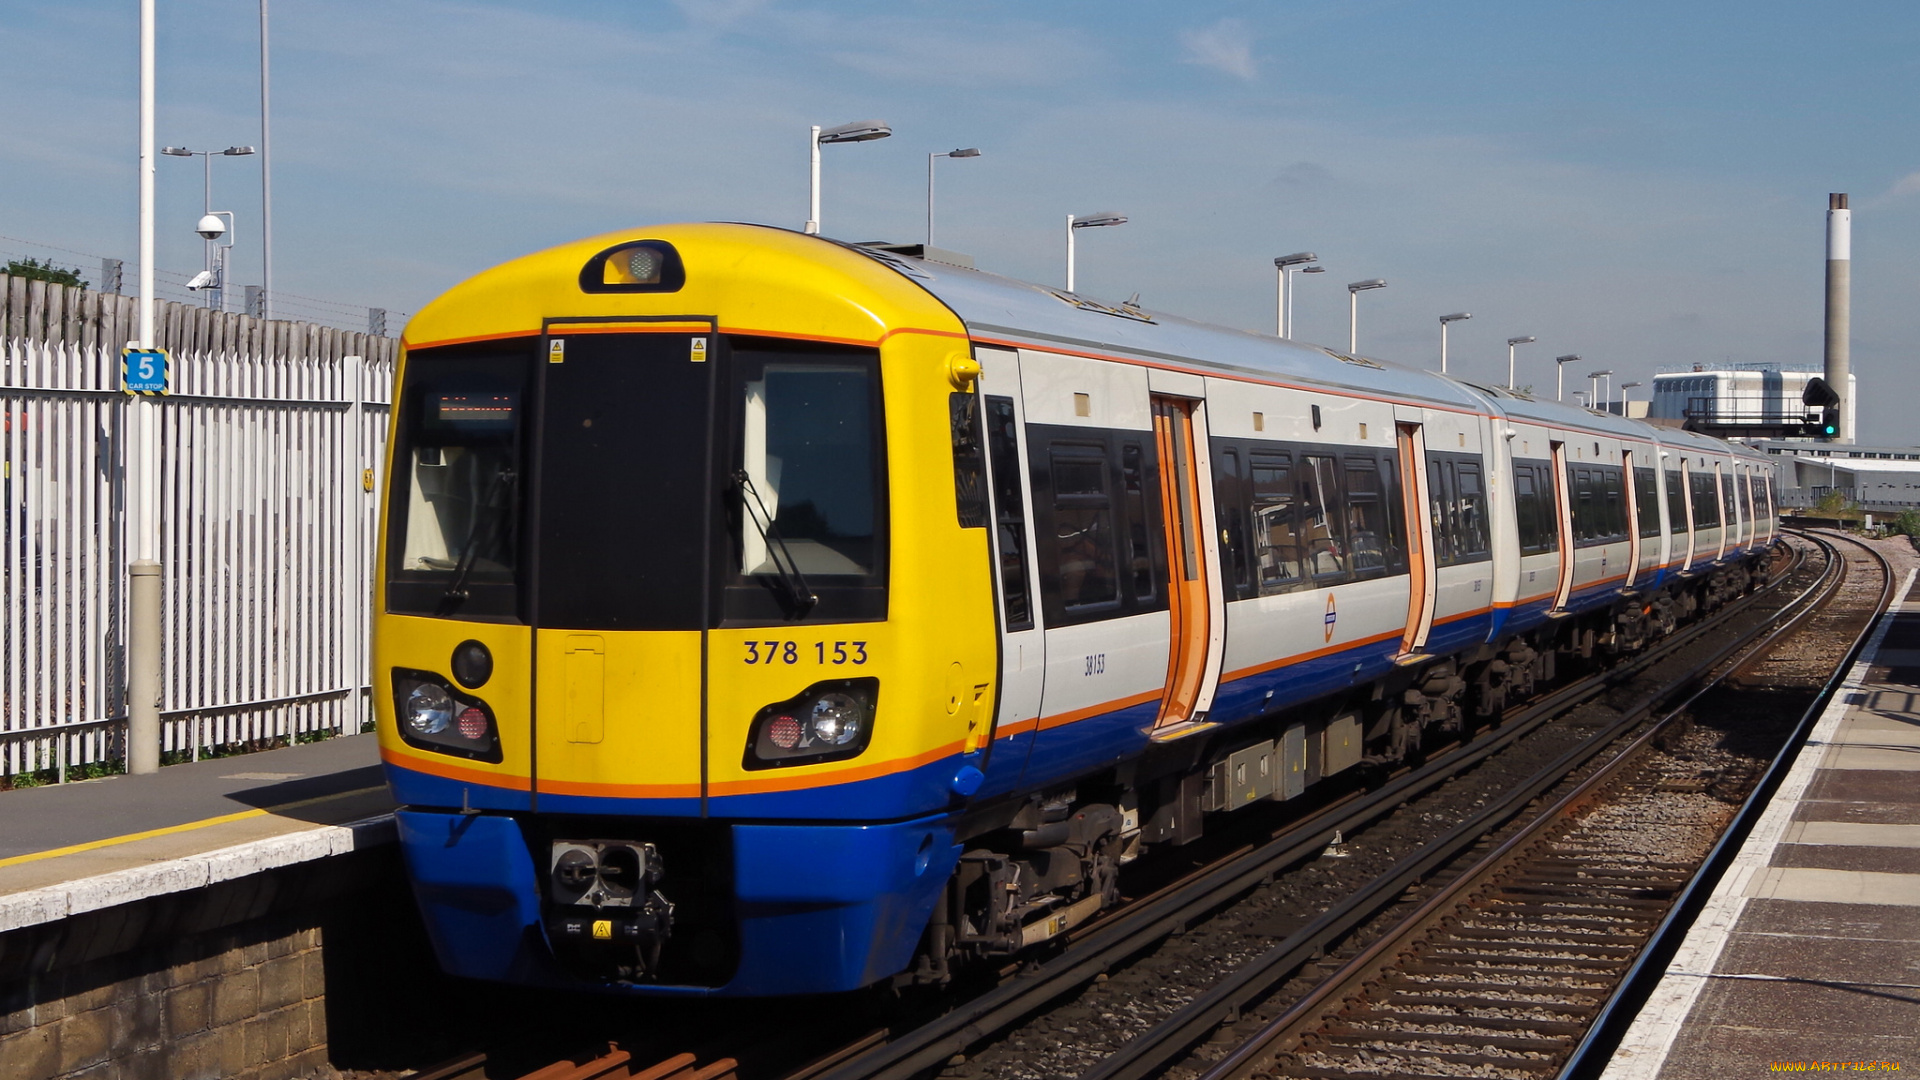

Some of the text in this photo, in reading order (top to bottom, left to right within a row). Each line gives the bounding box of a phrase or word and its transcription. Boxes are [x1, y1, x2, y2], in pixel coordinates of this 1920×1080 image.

[138, 356, 154, 380] 5
[743, 640, 868, 665] 378 153
[1085, 653, 1105, 676] 38153
